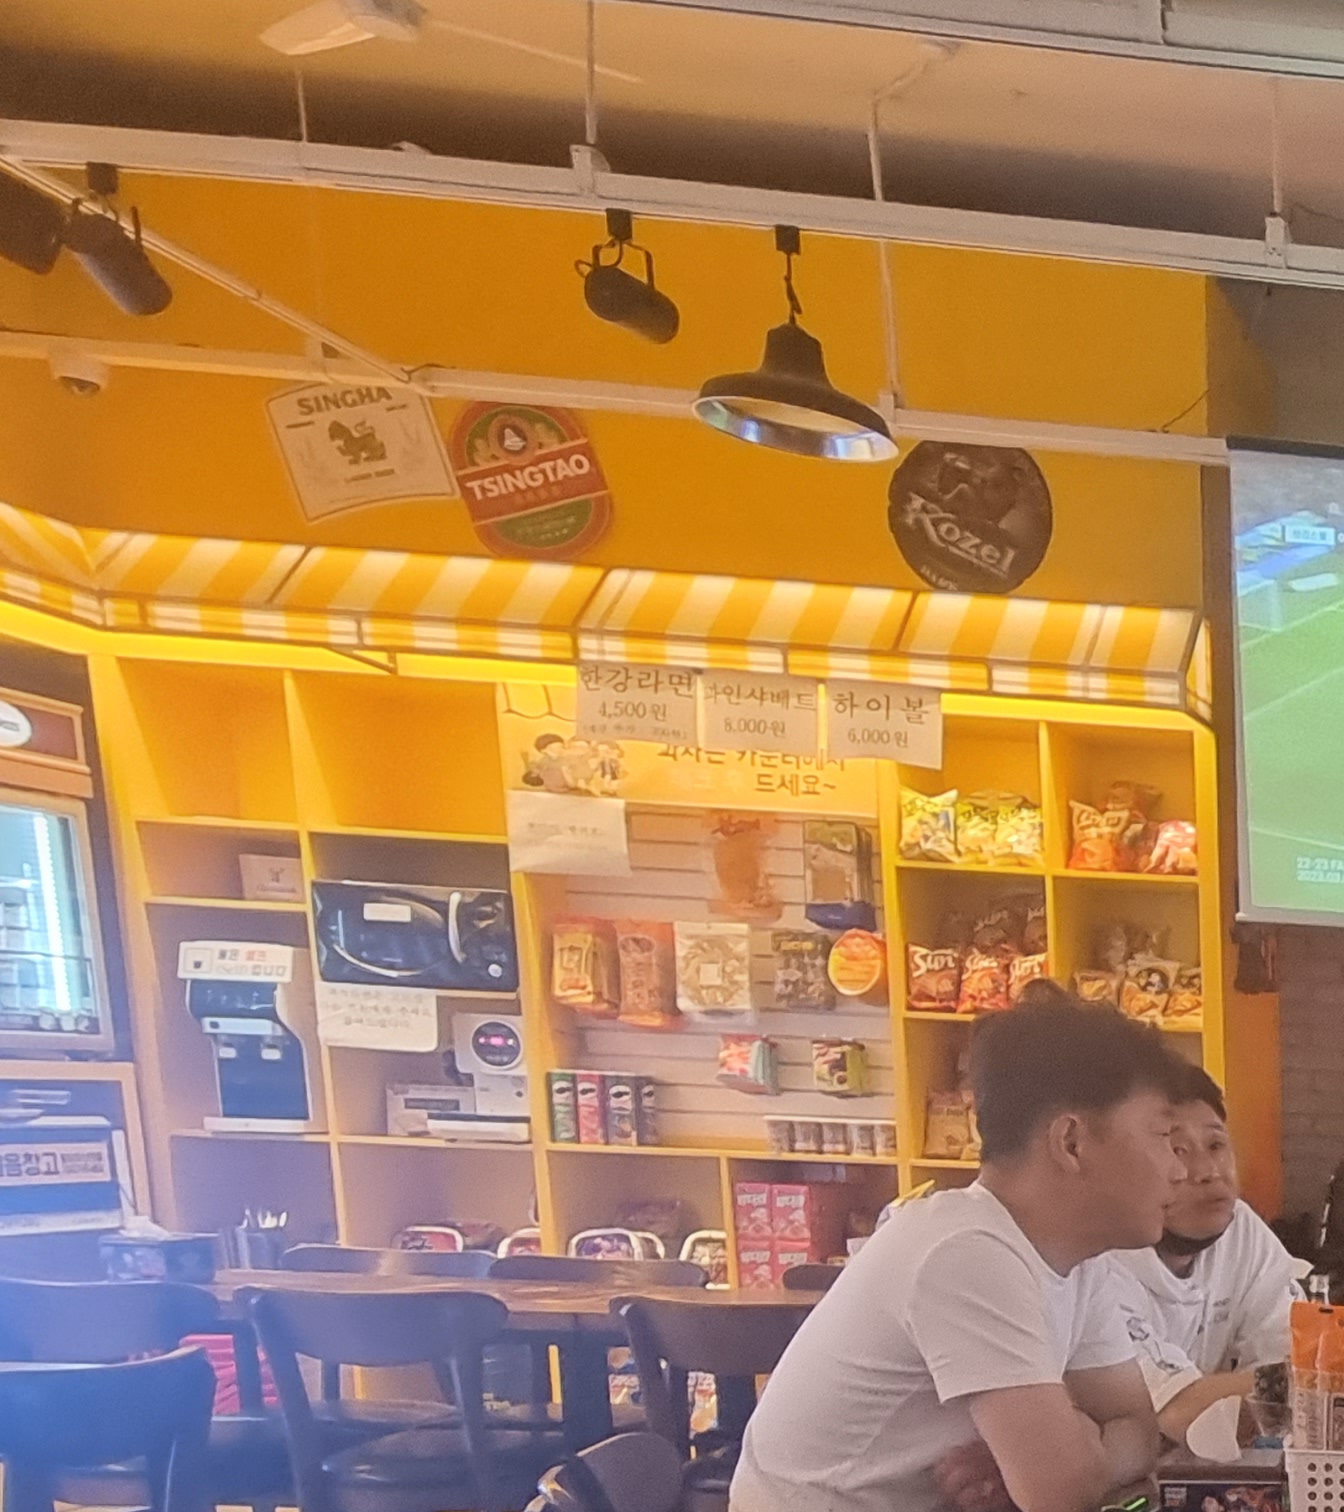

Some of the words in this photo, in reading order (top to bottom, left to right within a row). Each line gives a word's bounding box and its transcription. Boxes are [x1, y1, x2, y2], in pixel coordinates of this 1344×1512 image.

[297, 386, 392, 416] SINGHA
[465, 454, 590, 500] TSINGTAO
[903, 492, 1016, 574] Kozel
[579, 667, 695, 698] 한강라면
[834, 691, 929, 724] 하이볼
